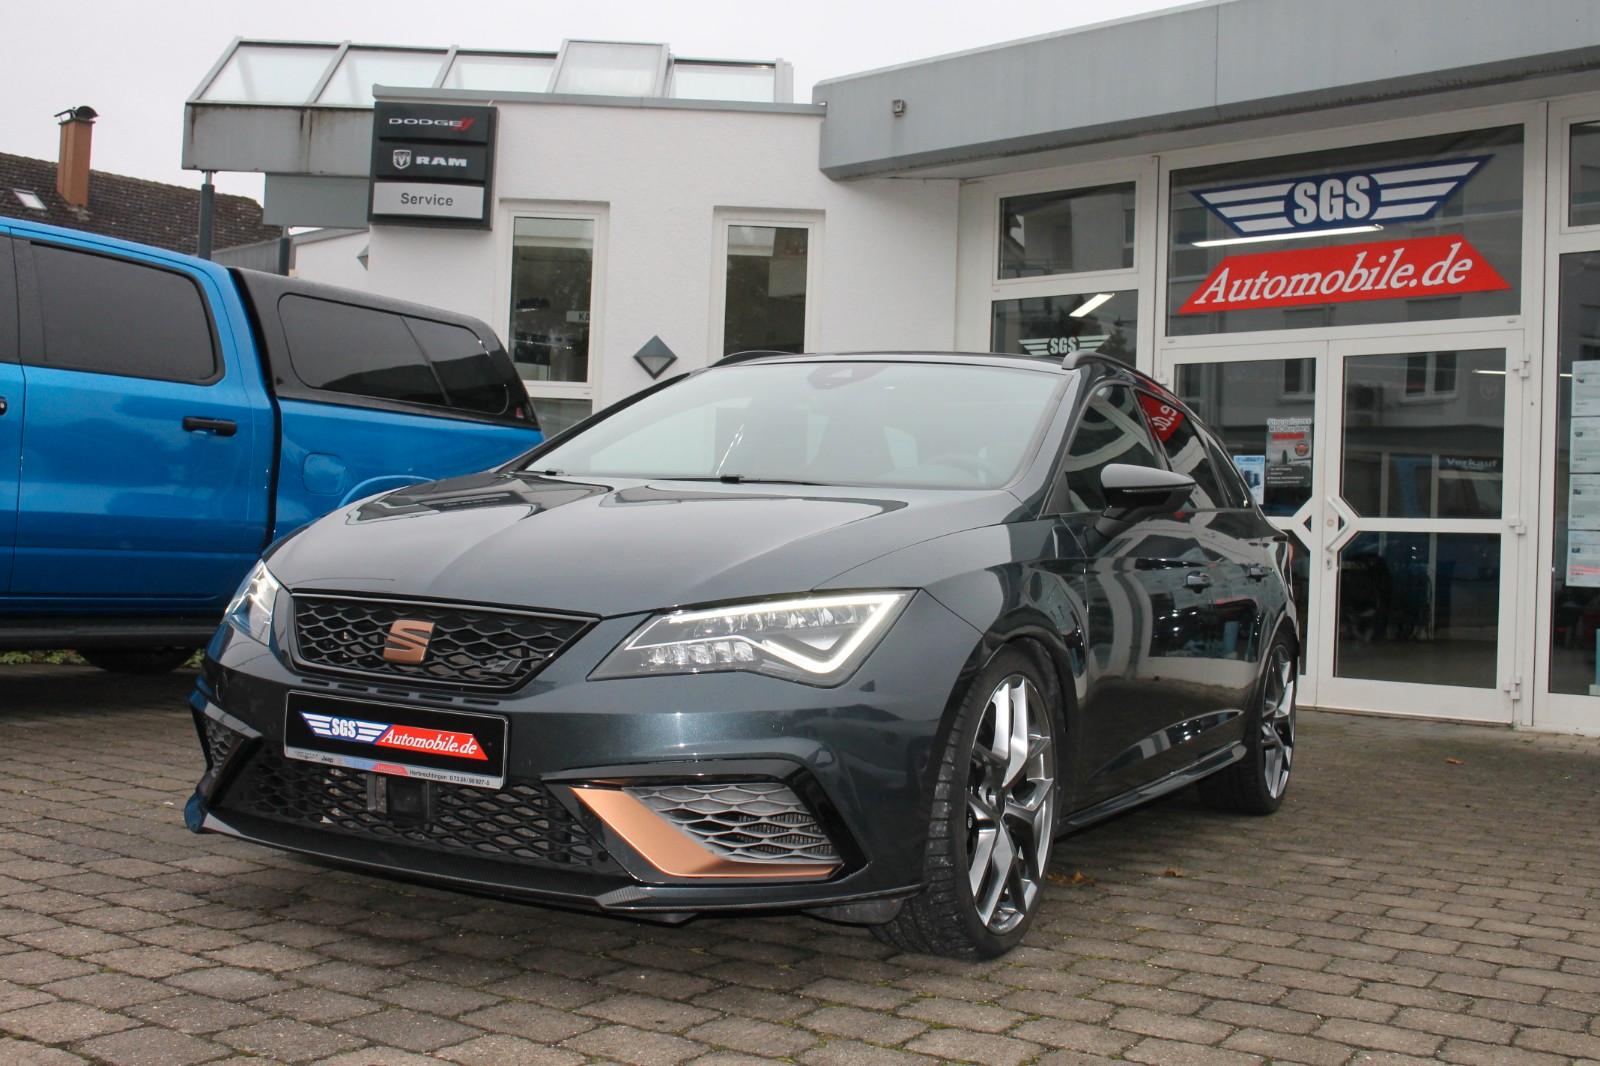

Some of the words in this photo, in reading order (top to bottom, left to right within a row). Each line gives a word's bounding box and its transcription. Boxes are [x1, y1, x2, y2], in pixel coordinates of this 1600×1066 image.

[388, 118, 463, 127] DODGE
[415, 155, 467, 167] RAM
[400, 192, 454, 206] Service
[1293, 174, 1372, 225] SGS
[1194, 242, 1474, 305] Automobile.de
[1049, 336, 1077, 354] SGS
[331, 717, 356, 737] SGS
[382, 729, 477, 754] Automobile.de
